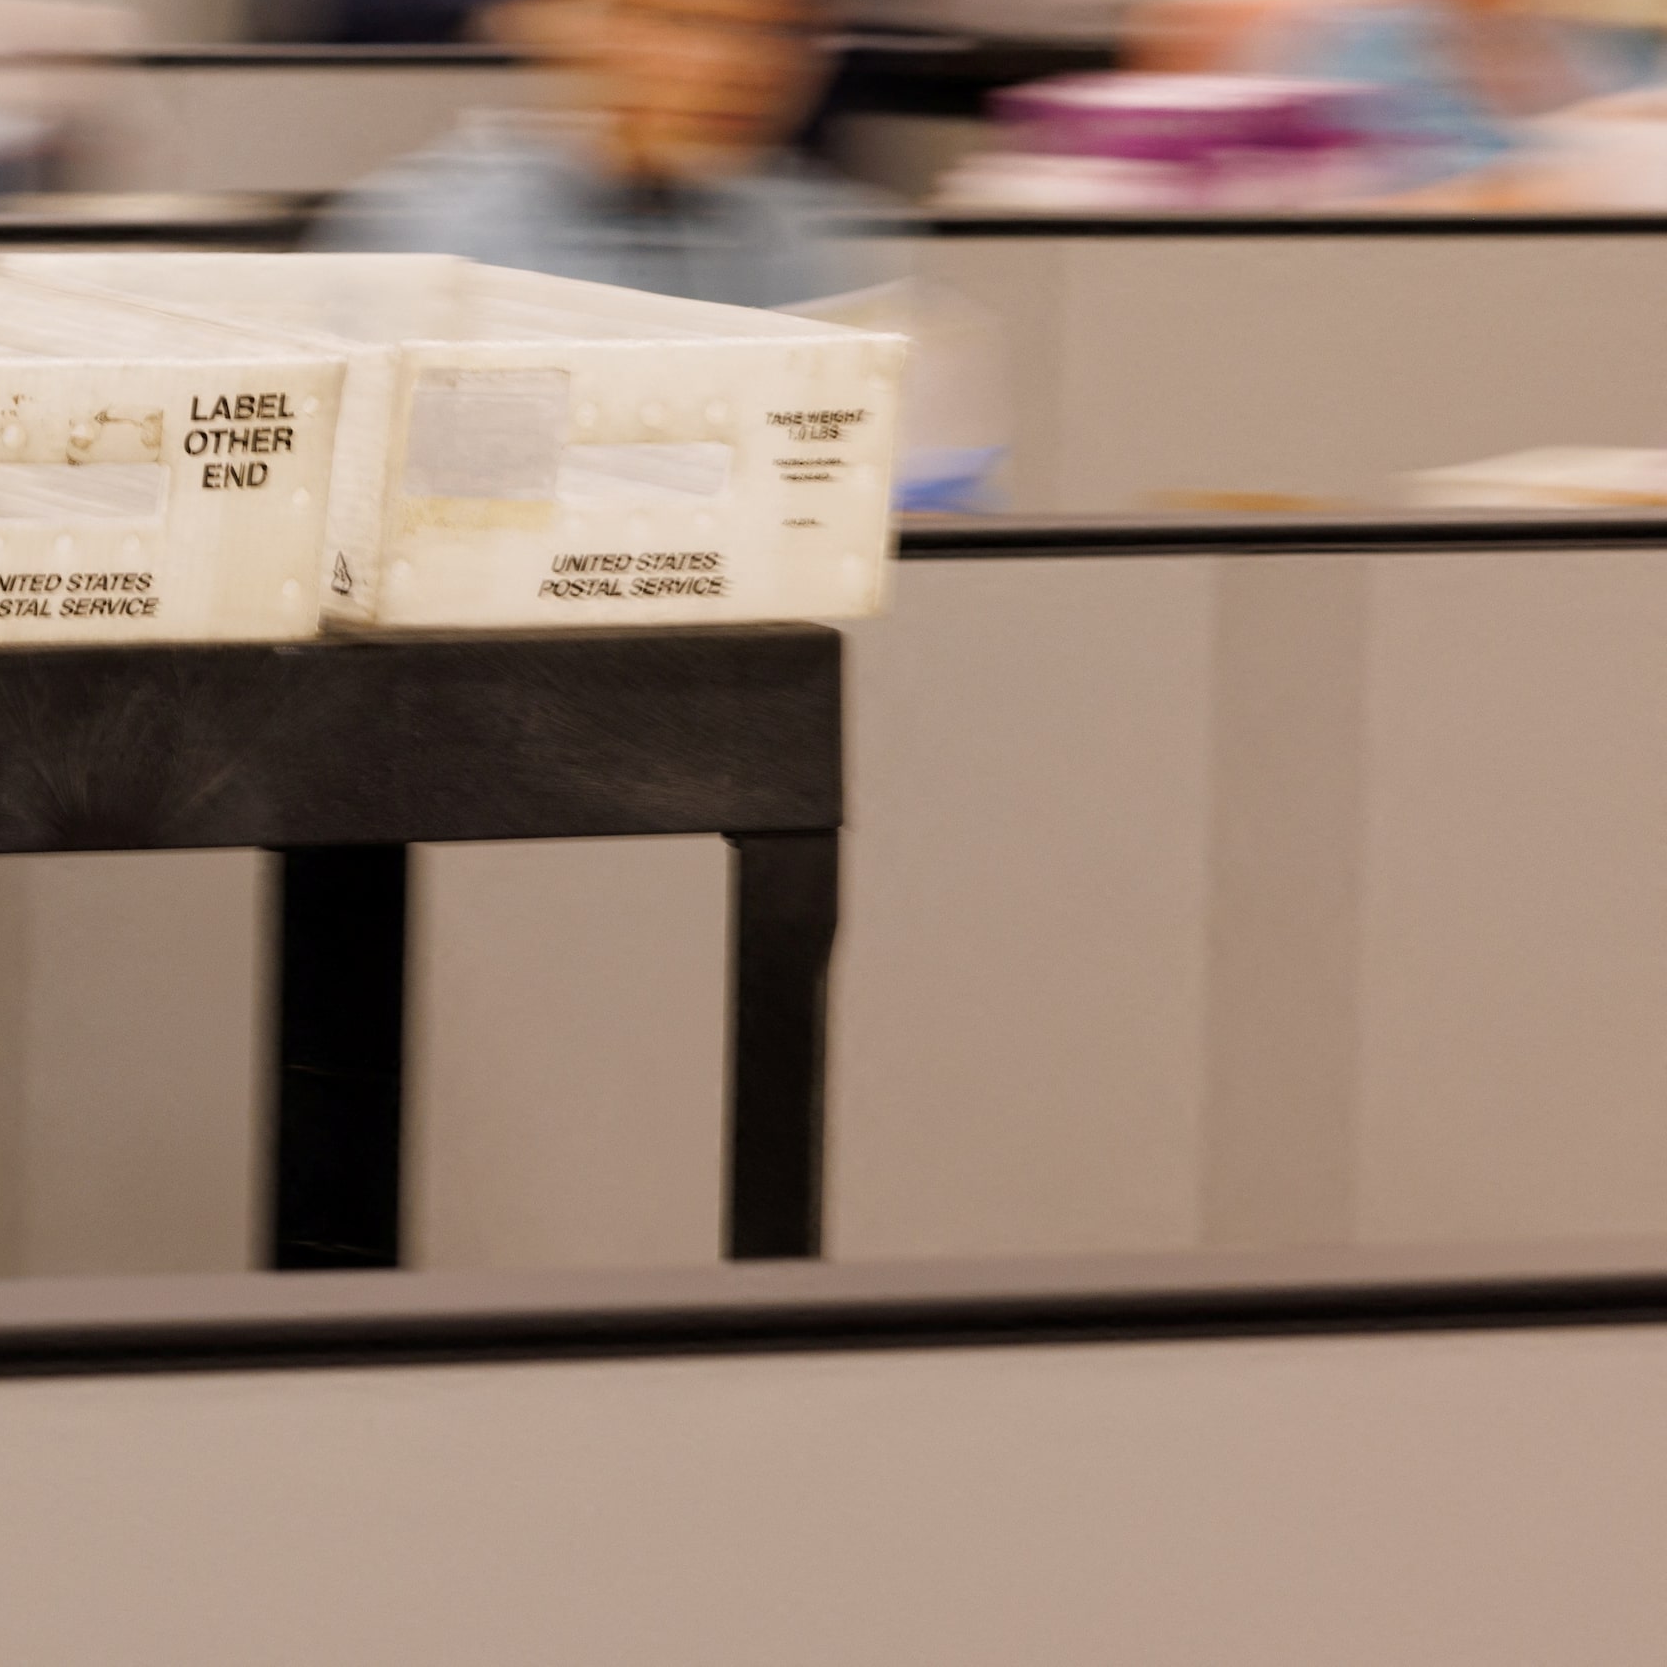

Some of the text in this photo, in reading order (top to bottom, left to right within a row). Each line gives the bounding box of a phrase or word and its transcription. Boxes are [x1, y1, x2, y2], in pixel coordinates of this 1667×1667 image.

[190, 392, 295, 421] LABEL
[766, 408, 866, 425] TARE WEIGHT
[183, 425, 294, 456] OTHER
[201, 460, 269, 489] END
[551, 551, 722, 574] UNITED STATES
[66, 571, 154, 592] STATES
[537, 575, 729, 599] POSTAL SERVICE
[58, 596, 160, 618] SERVICE
